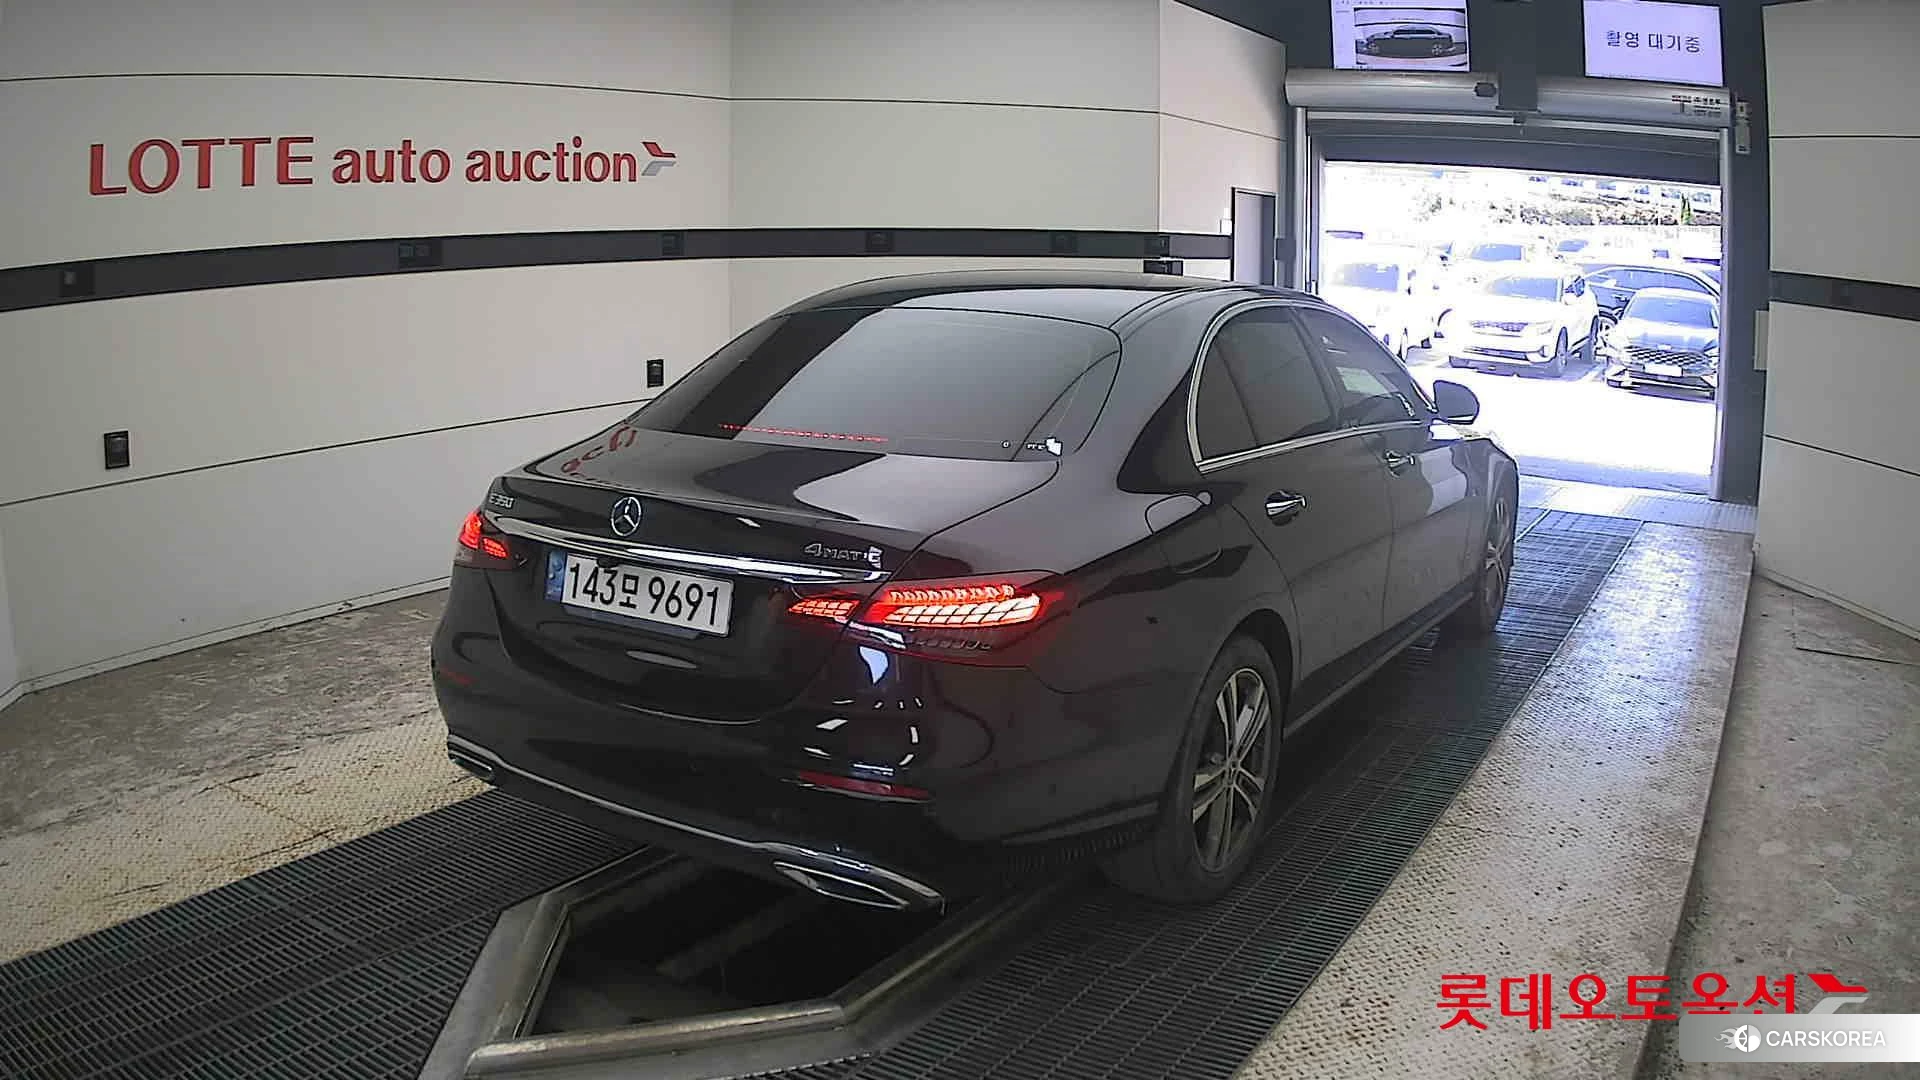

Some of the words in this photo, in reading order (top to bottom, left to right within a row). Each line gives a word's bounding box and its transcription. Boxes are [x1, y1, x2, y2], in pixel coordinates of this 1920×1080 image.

[1606, 30, 1639, 48] 촬영
[1649, 33, 1700, 53] 대기중
[90, 136, 314, 195] LOTTE
[332, 141, 450, 183] auto
[465, 135, 638, 183] auction
[569, 563, 639, 609] 143모
[648, 575, 721, 626] 9691
